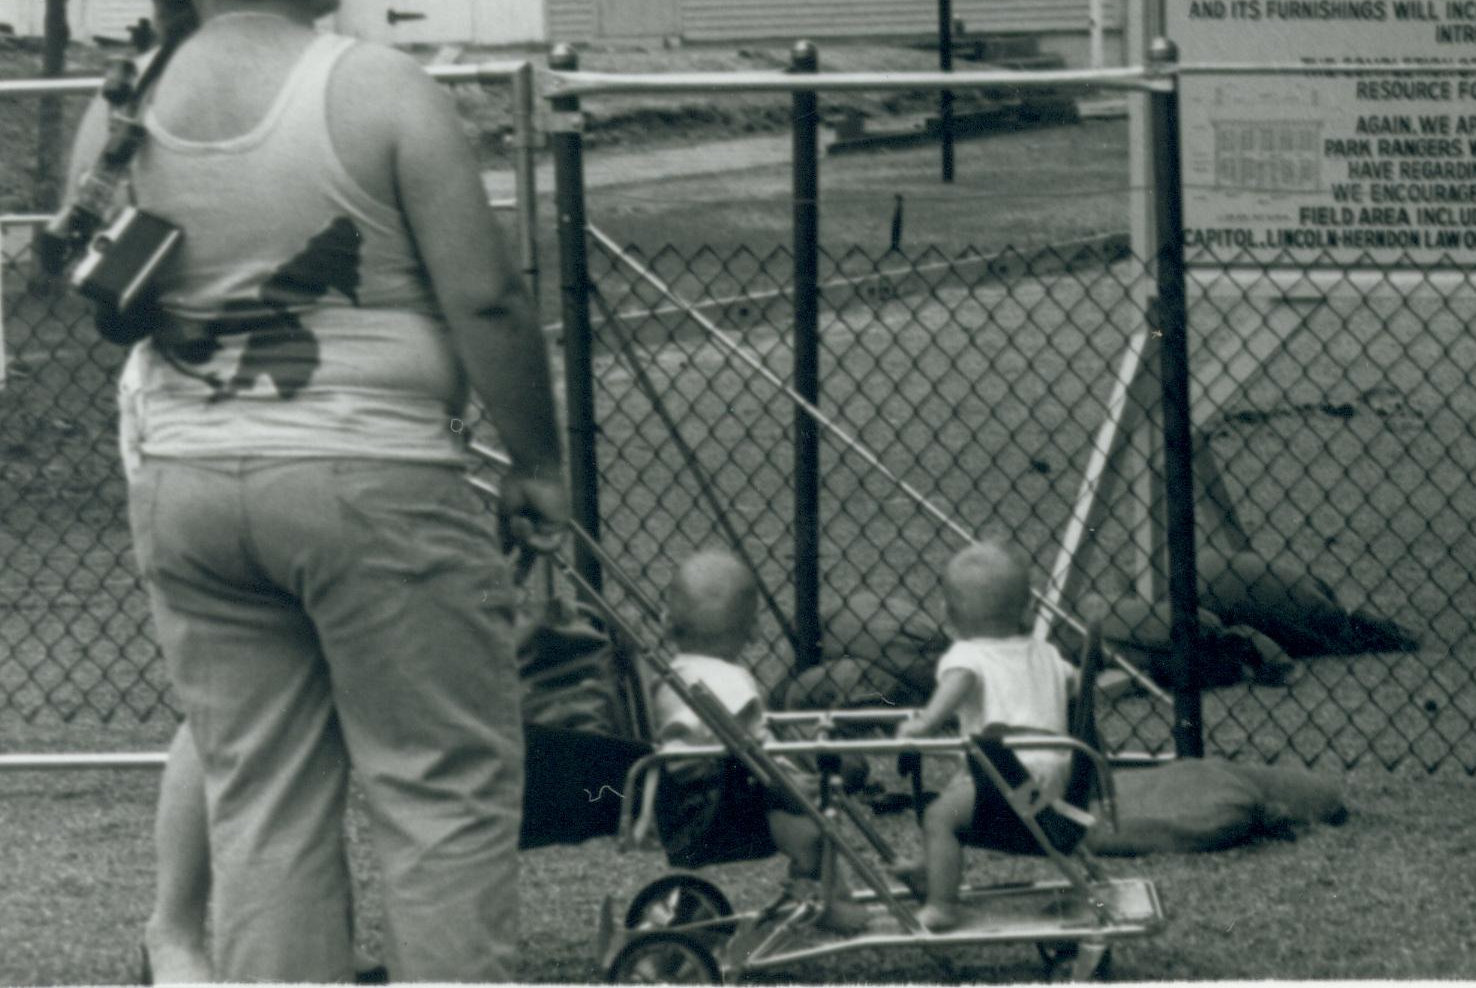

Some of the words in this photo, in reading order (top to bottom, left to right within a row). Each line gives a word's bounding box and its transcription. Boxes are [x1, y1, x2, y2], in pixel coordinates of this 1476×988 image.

[1188, 1, 1226, 22] AND
[1231, 1, 1261, 21] ITS
[1265, 1, 1387, 21] FURNISHINGS
[1393, 0, 1439, 21] WILL
[1356, 80, 1452, 101] RESOURCE
[1419, 116, 1450, 135] WE
[1324, 138, 1372, 158] PARK
[1378, 139, 1465, 158] RANGERS
[1347, 161, 1395, 180] HAVE
[1330, 183, 1363, 204] WE
[1299, 206, 1354, 226] FIELD
[1359, 206, 1411, 226] AREA
[1424, 229, 1461, 251] LAW
